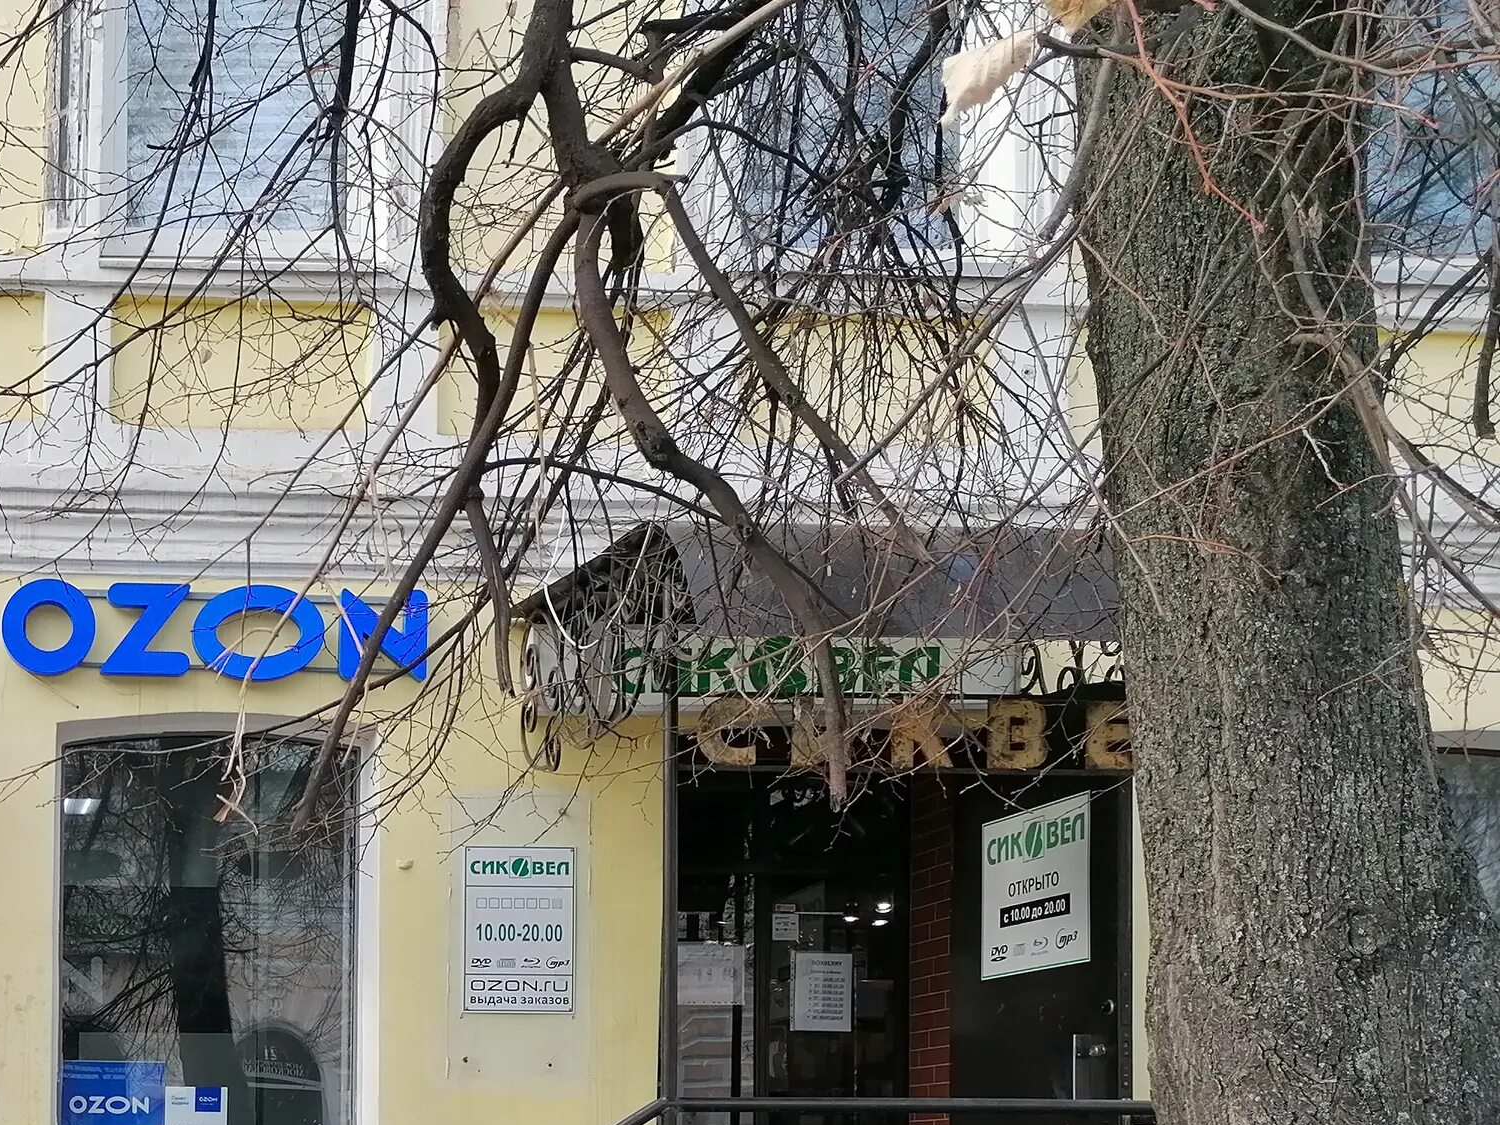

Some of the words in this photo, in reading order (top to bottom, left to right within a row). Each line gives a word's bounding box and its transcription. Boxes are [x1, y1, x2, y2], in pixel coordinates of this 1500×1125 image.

[1, 578, 428, 682] OZON
[1008, 871, 1060, 897] ОТКРЫТО
[1003, 914, 1009, 924] с
[1011, 907, 1031, 921] 10.00
[1031, 907, 1043, 920] до
[1044, 899, 1066, 916] 20.00
[476, 923, 563, 943] 10.00-20.00
[470, 996, 517, 1006] выдача
[521, 996, 570, 1005] заказов
[69, 1095, 150, 1115] OZON
